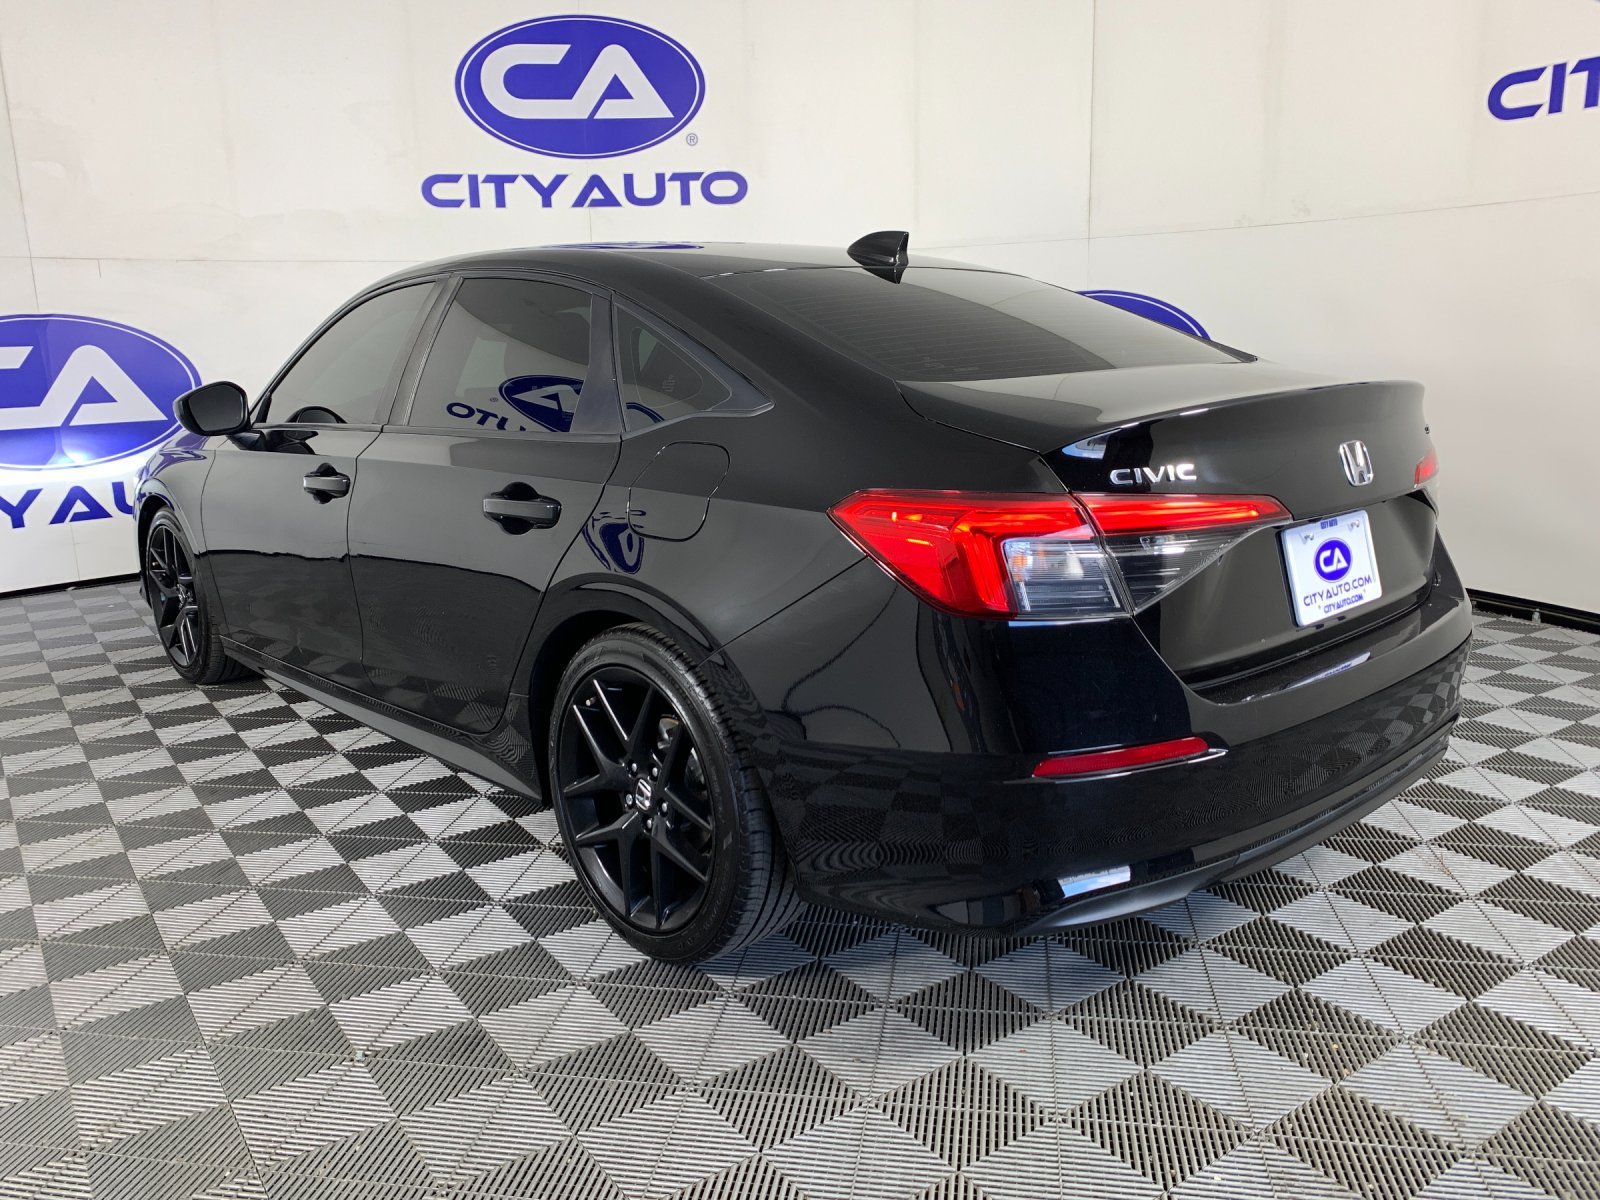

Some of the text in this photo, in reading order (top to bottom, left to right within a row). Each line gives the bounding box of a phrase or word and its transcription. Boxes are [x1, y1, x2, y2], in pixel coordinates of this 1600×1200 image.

[480, 43, 675, 120] CA
[1109, 463, 1197, 486] CIVIC
[1319, 547, 1348, 573] CA
